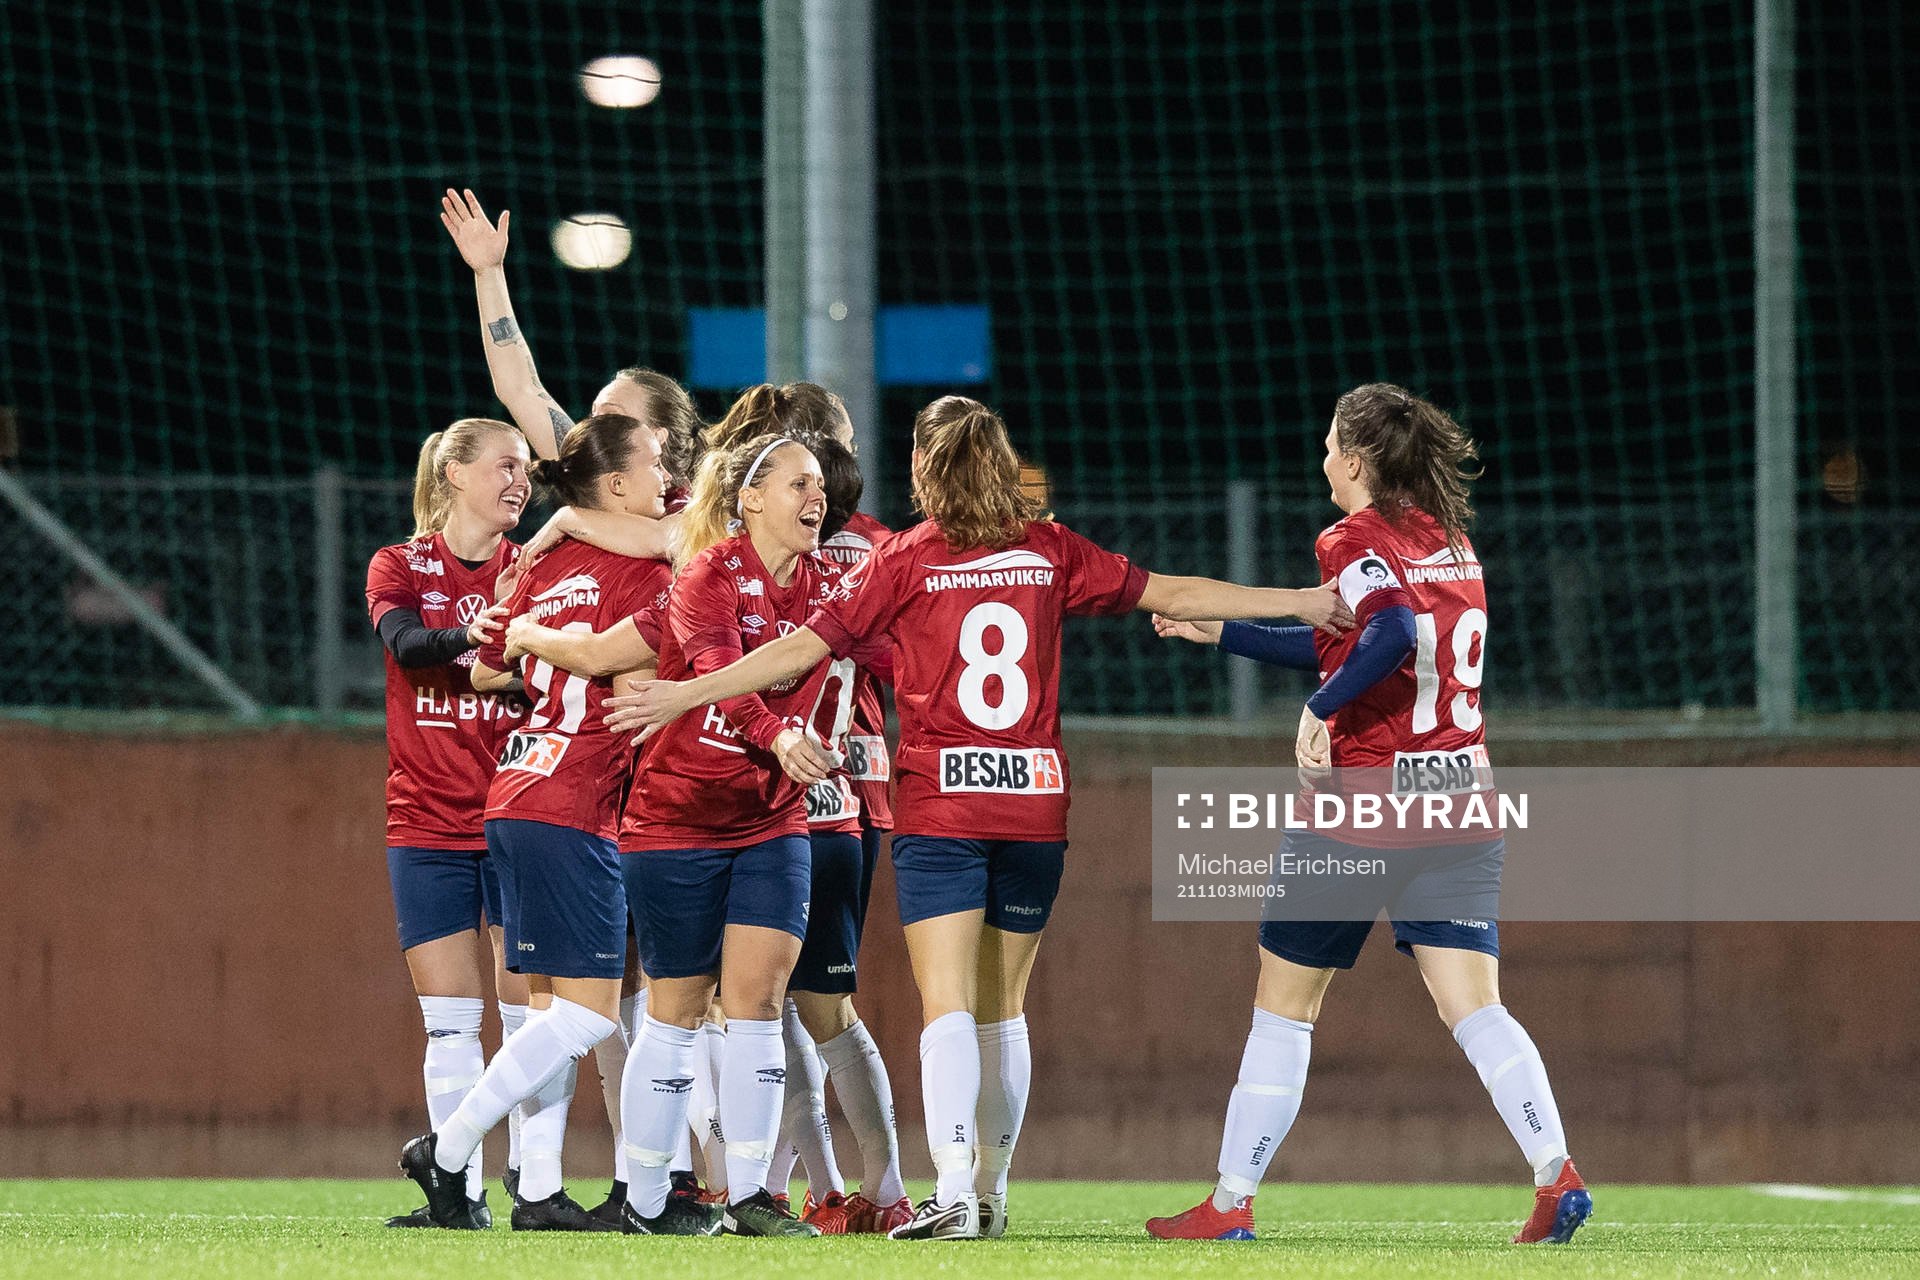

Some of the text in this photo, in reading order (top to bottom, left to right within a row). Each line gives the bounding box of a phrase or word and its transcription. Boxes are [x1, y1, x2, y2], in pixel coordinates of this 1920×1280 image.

[925, 569, 1054, 593] HAMMARVIKEN
[422, 603, 446, 611] umbro
[957, 601, 1029, 731] 8
[1412, 608, 1487, 734] 19
[945, 752, 1030, 789] BESAB
[1397, 754, 1475, 792] BESAB
[1005, 903, 1042, 915] umbro
[1522, 1101, 1541, 1134] umbro
[1250, 1135, 1271, 1166] umbro
